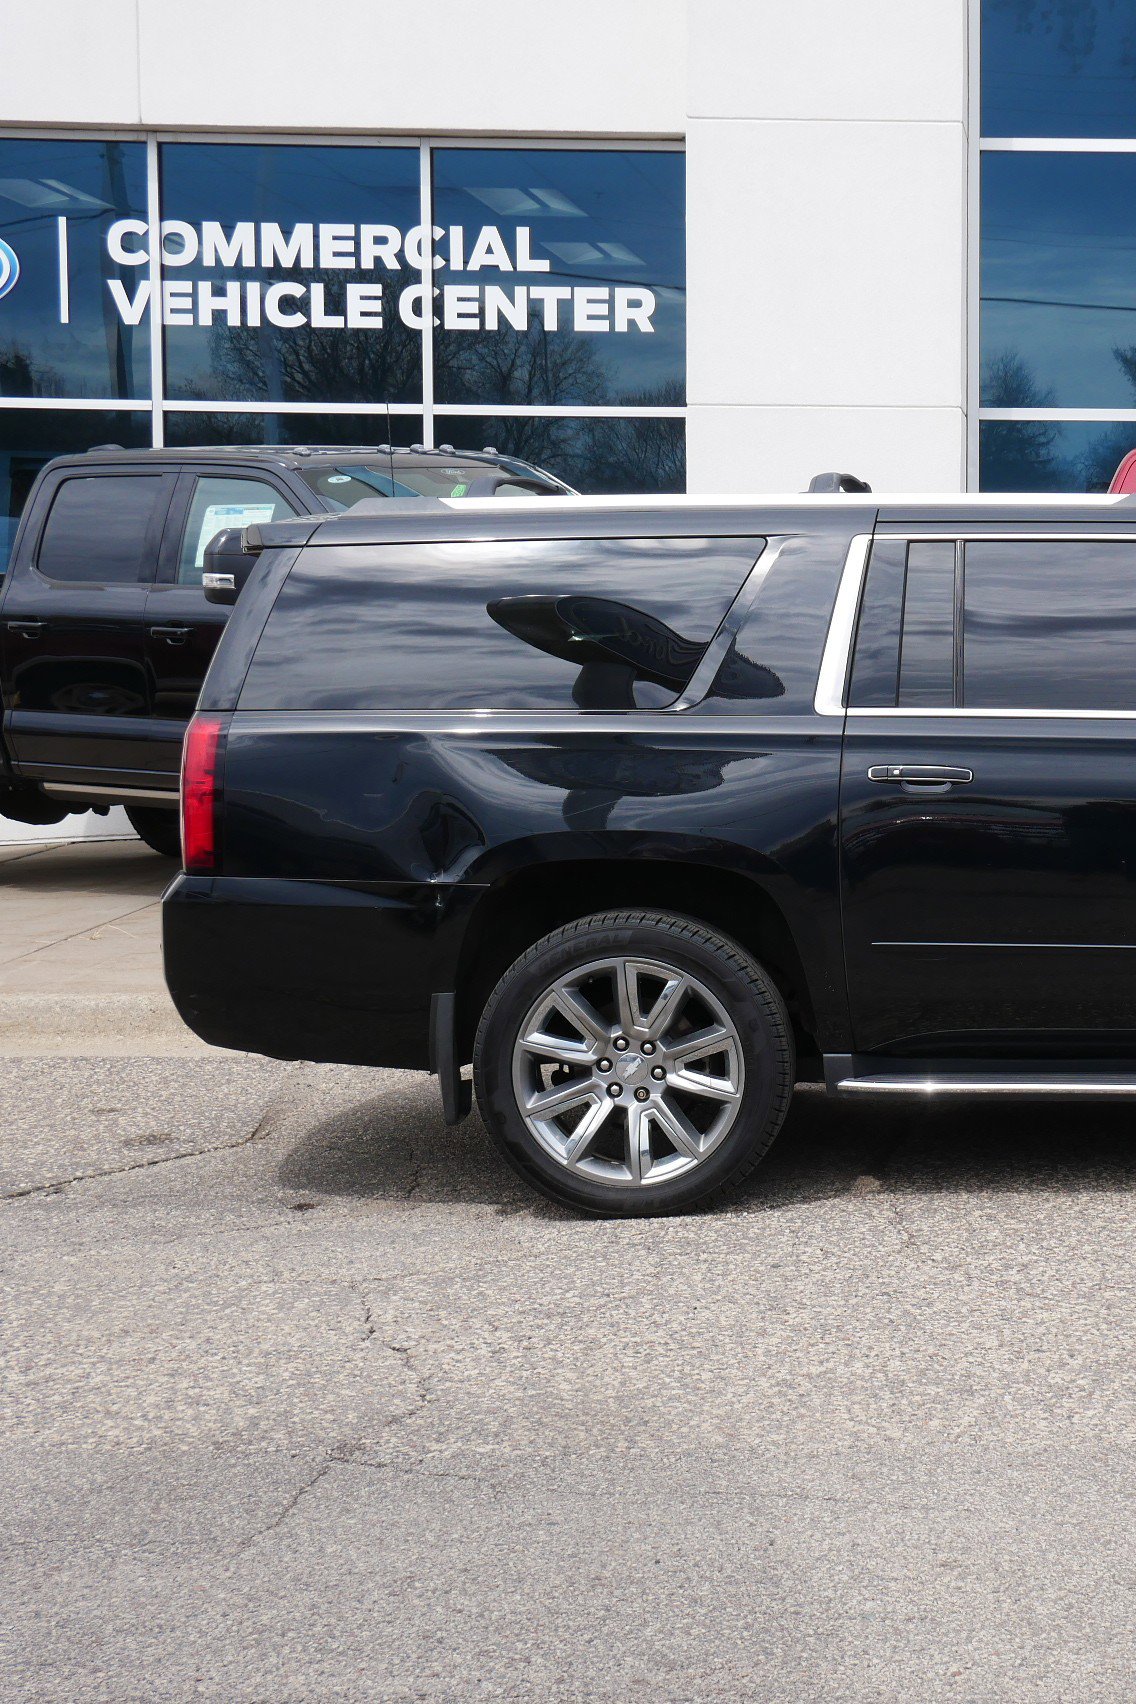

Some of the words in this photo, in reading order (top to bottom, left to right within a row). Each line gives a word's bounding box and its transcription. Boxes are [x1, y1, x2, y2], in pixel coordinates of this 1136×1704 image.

[108, 219, 550, 272] COMMERCIAL
[107, 279, 383, 329] VEHICLE
[398, 285, 656, 333] CENTER
